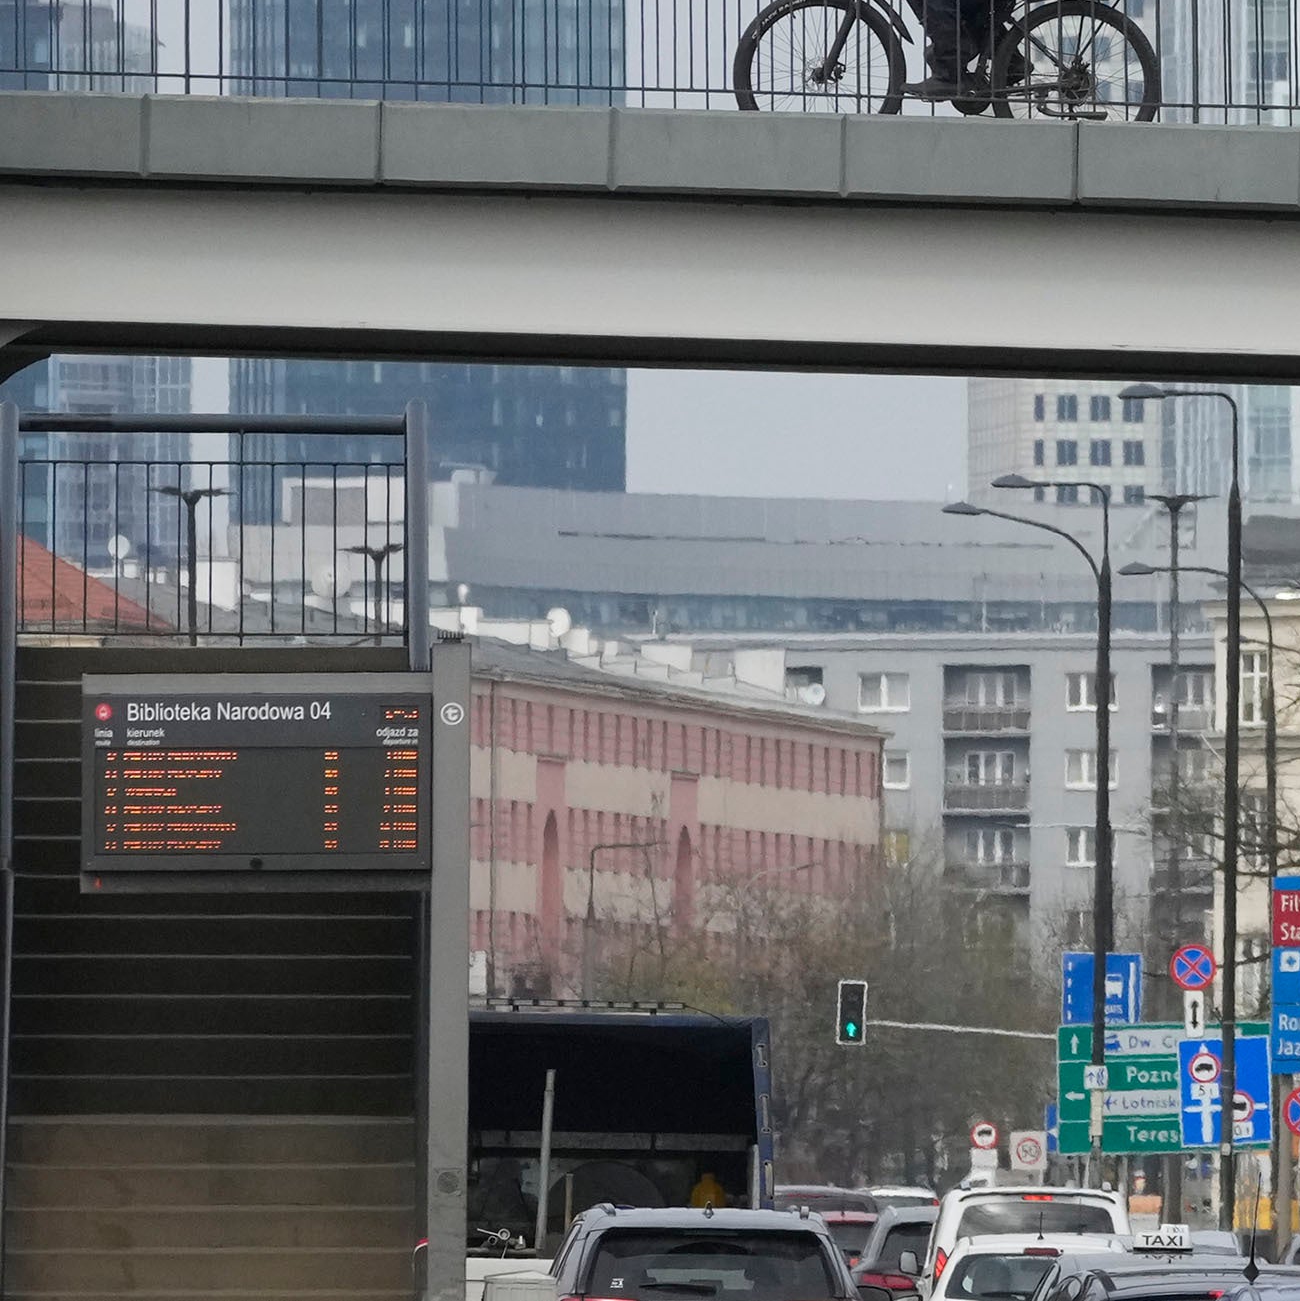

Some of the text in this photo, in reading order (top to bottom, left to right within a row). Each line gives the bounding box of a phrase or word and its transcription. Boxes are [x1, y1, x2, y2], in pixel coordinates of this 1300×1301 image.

[127, 702, 331, 721] Biblioteka Narodowa 04
[127, 727, 165, 738] kierunek
[376, 726, 418, 739] odjazd za
[1122, 1094, 1179, 1109] Lotnisk
[1142, 1235, 1182, 1246] TAXI
